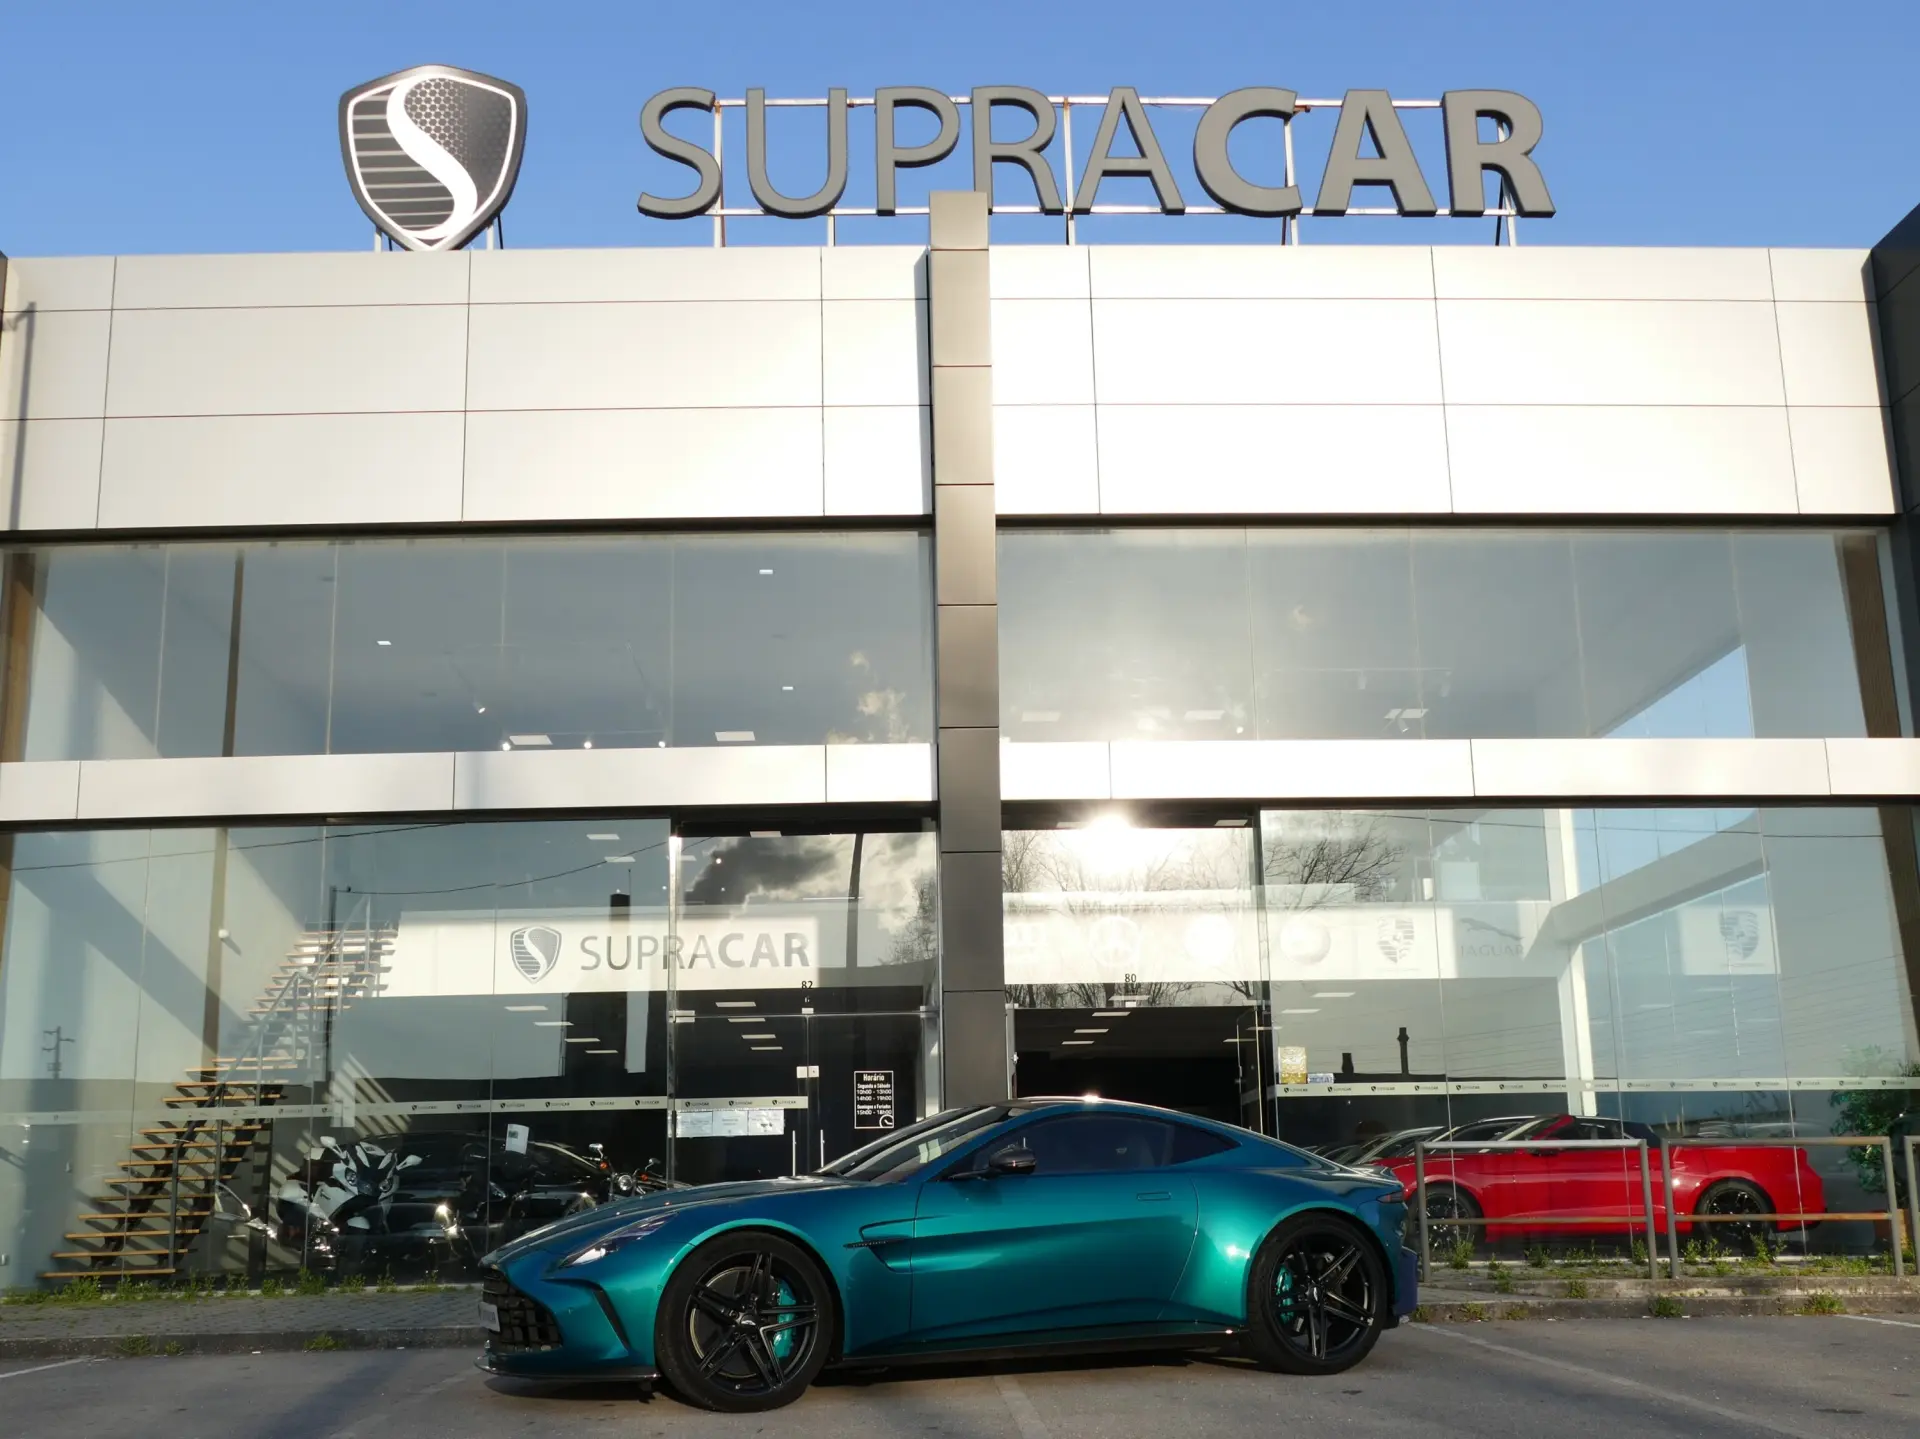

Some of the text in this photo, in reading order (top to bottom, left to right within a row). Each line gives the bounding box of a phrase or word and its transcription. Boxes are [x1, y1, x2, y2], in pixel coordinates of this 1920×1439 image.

[637, 85, 1556, 218] SUPRACAR
[580, 932, 810, 971] SUPRACAR
[801, 980, 813, 990] 82
[1124, 973, 1137, 983] 80
